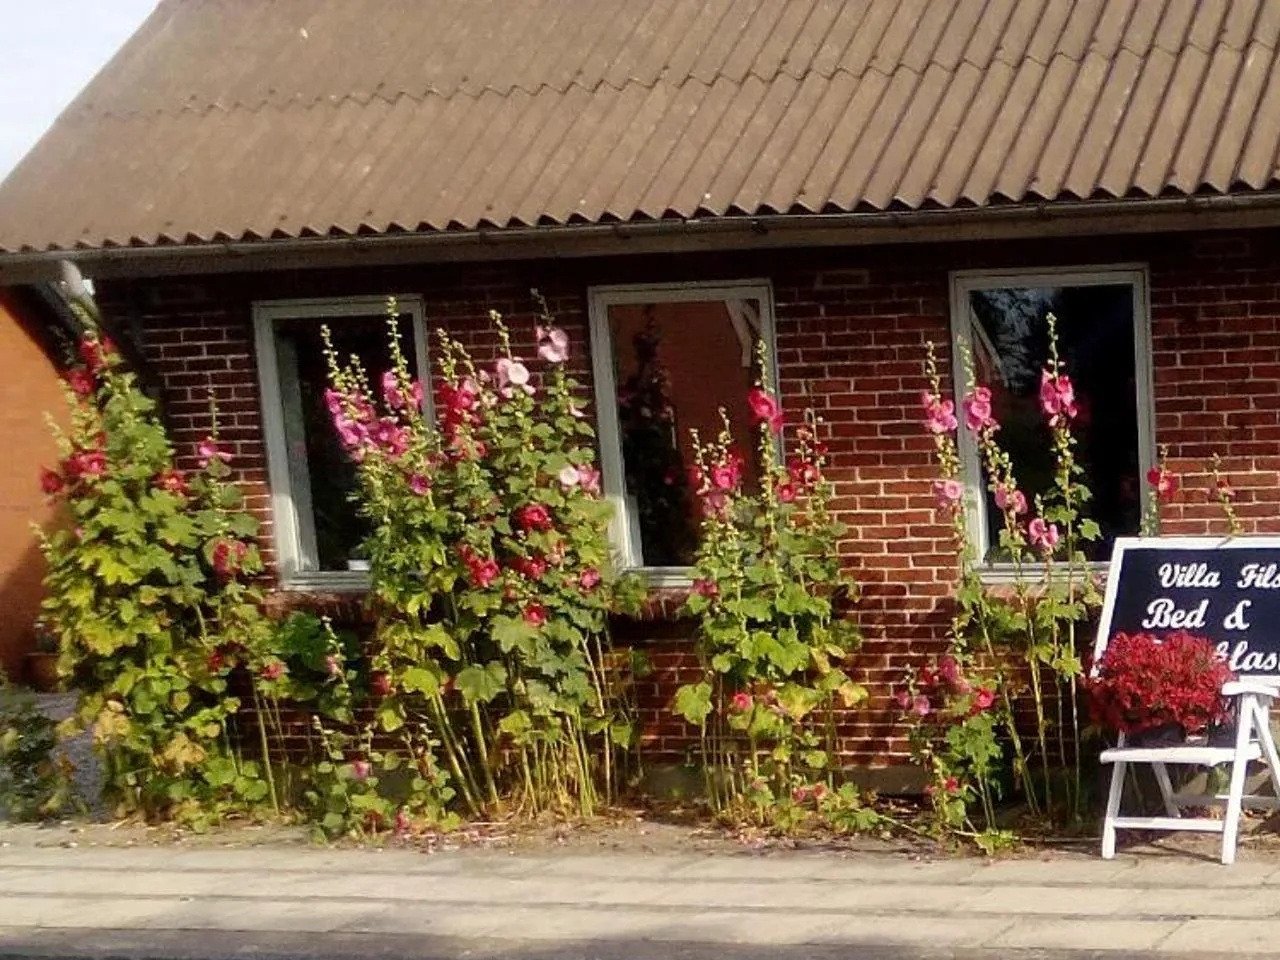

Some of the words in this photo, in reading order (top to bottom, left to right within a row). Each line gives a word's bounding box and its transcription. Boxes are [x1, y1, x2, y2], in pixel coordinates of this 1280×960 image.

[1158, 562, 1221, 588] Villa
[1141, 598, 1209, 629] Bed
[1223, 599, 1252, 630] &
